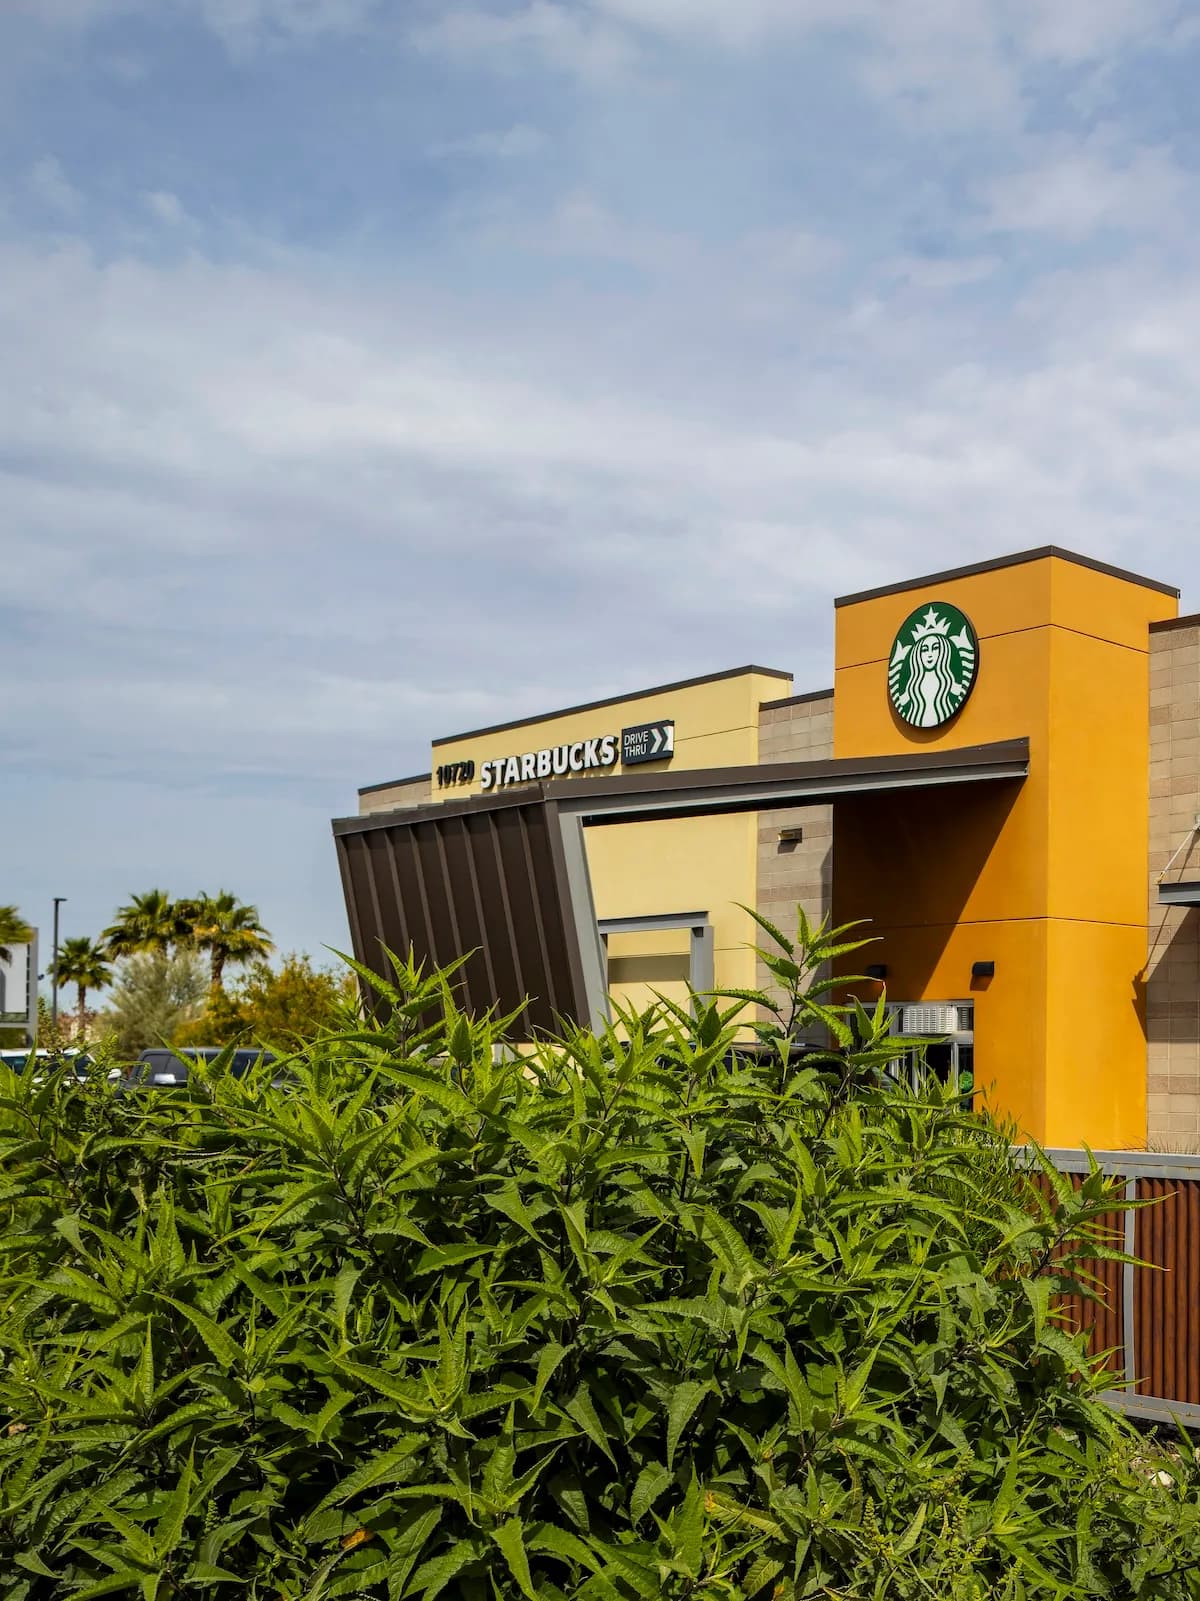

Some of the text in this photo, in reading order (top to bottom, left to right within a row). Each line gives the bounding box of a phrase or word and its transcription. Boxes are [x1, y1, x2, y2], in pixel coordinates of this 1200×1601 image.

[624, 730, 649, 746] DRIVE
[624, 743, 647, 758] THRU
[480, 735, 616, 789] STARBUCKS
